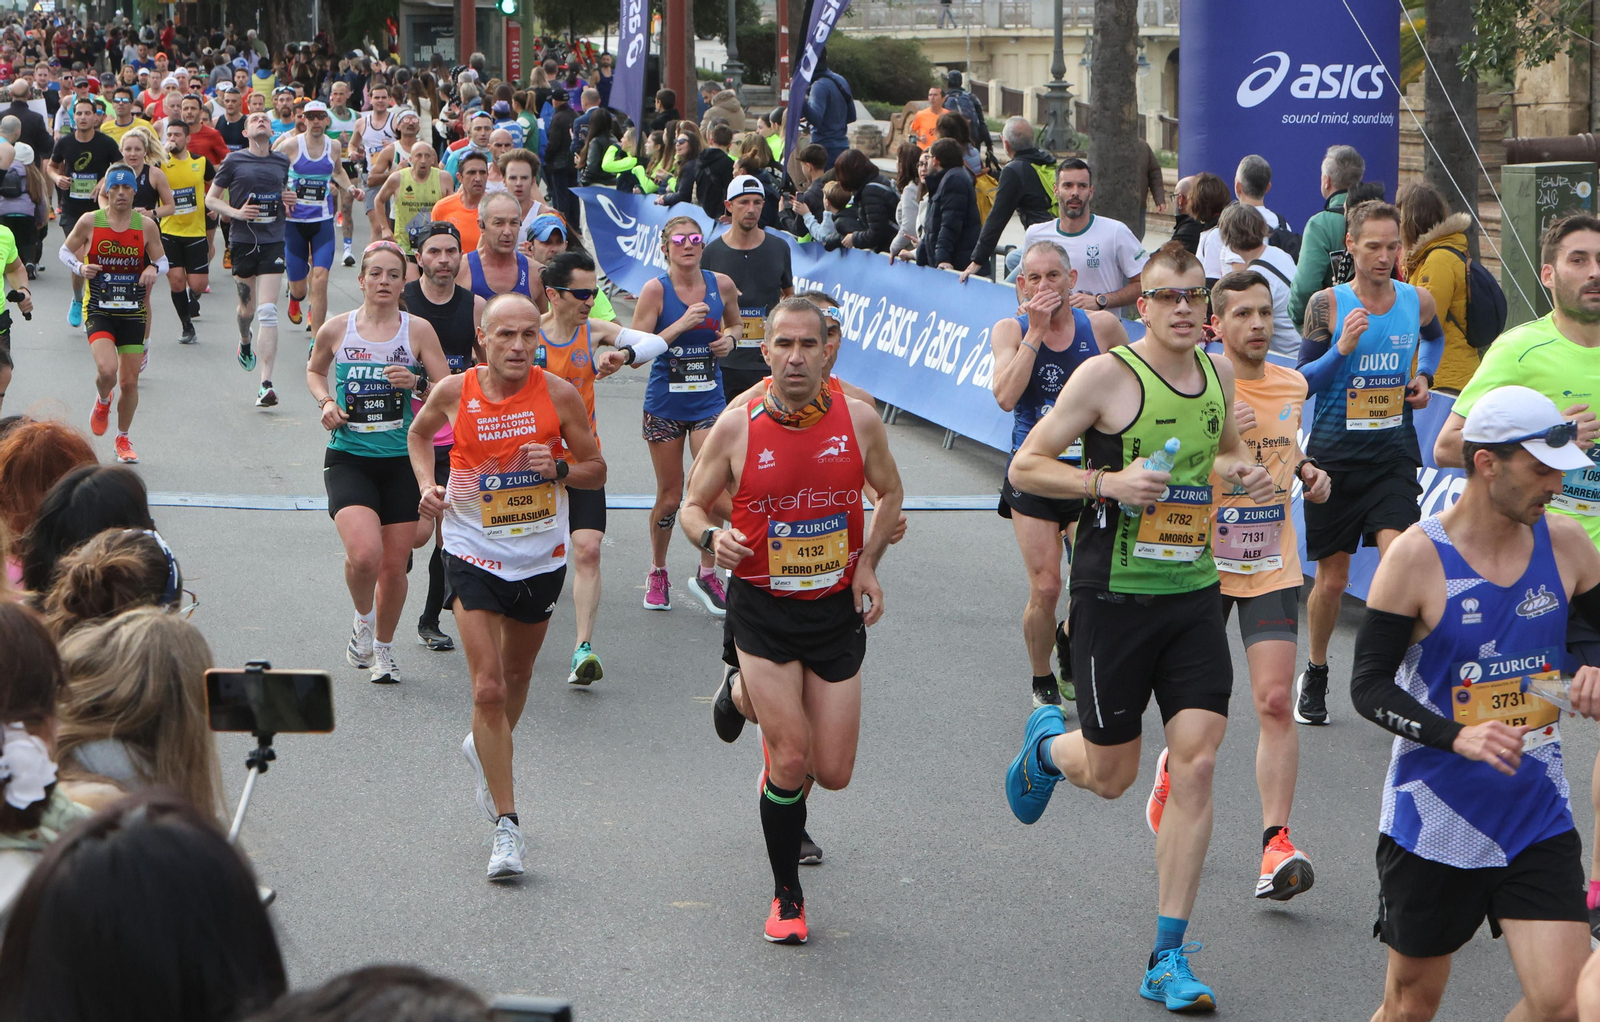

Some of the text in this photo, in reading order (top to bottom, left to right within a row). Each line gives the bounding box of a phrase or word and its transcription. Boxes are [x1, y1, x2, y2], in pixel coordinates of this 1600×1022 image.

[512, 40, 520, 69] PASEO
[1290, 64, 1386, 99] asics
[1282, 112, 1394, 126] sound mind, sound body
[97, 255, 140, 266] runners
[877, 304, 919, 358] asics
[687, 347, 712, 356] ZURIC
[924, 319, 969, 375] asics
[687, 363, 705, 371] 2965
[1359, 352, 1399, 372] DUXO
[347, 366, 388, 380] ATLE
[1369, 377, 1401, 386] ZURICH
[364, 400, 385, 409] 3246
[1368, 395, 1389, 404] 4106
[367, 413, 383, 421] SUSI
[476, 411, 535, 425] GRAN CANARIA
[477, 417, 536, 431] MASPALOMAS
[478, 425, 537, 441] MARATHON
[507, 495, 533, 507] 4528
[747, 486, 859, 514] artefísico
[1172, 489, 1208, 501] ZURICH
[491, 508, 550, 525] DANIELASILVIA
[1166, 513, 1193, 526] 4782
[1244, 509, 1280, 520] ZURICH
[797, 519, 839, 534] ZURICH
[1159, 532, 1194, 544] AMORÓS
[1242, 532, 1264, 543] 7131
[797, 545, 824, 558] 4132
[1120, 541, 1128, 567] CLUB
[782, 560, 840, 574] PEDRO PLAZA
[1489, 655, 1546, 676] ZURICH
[1492, 692, 1525, 709] 3731
